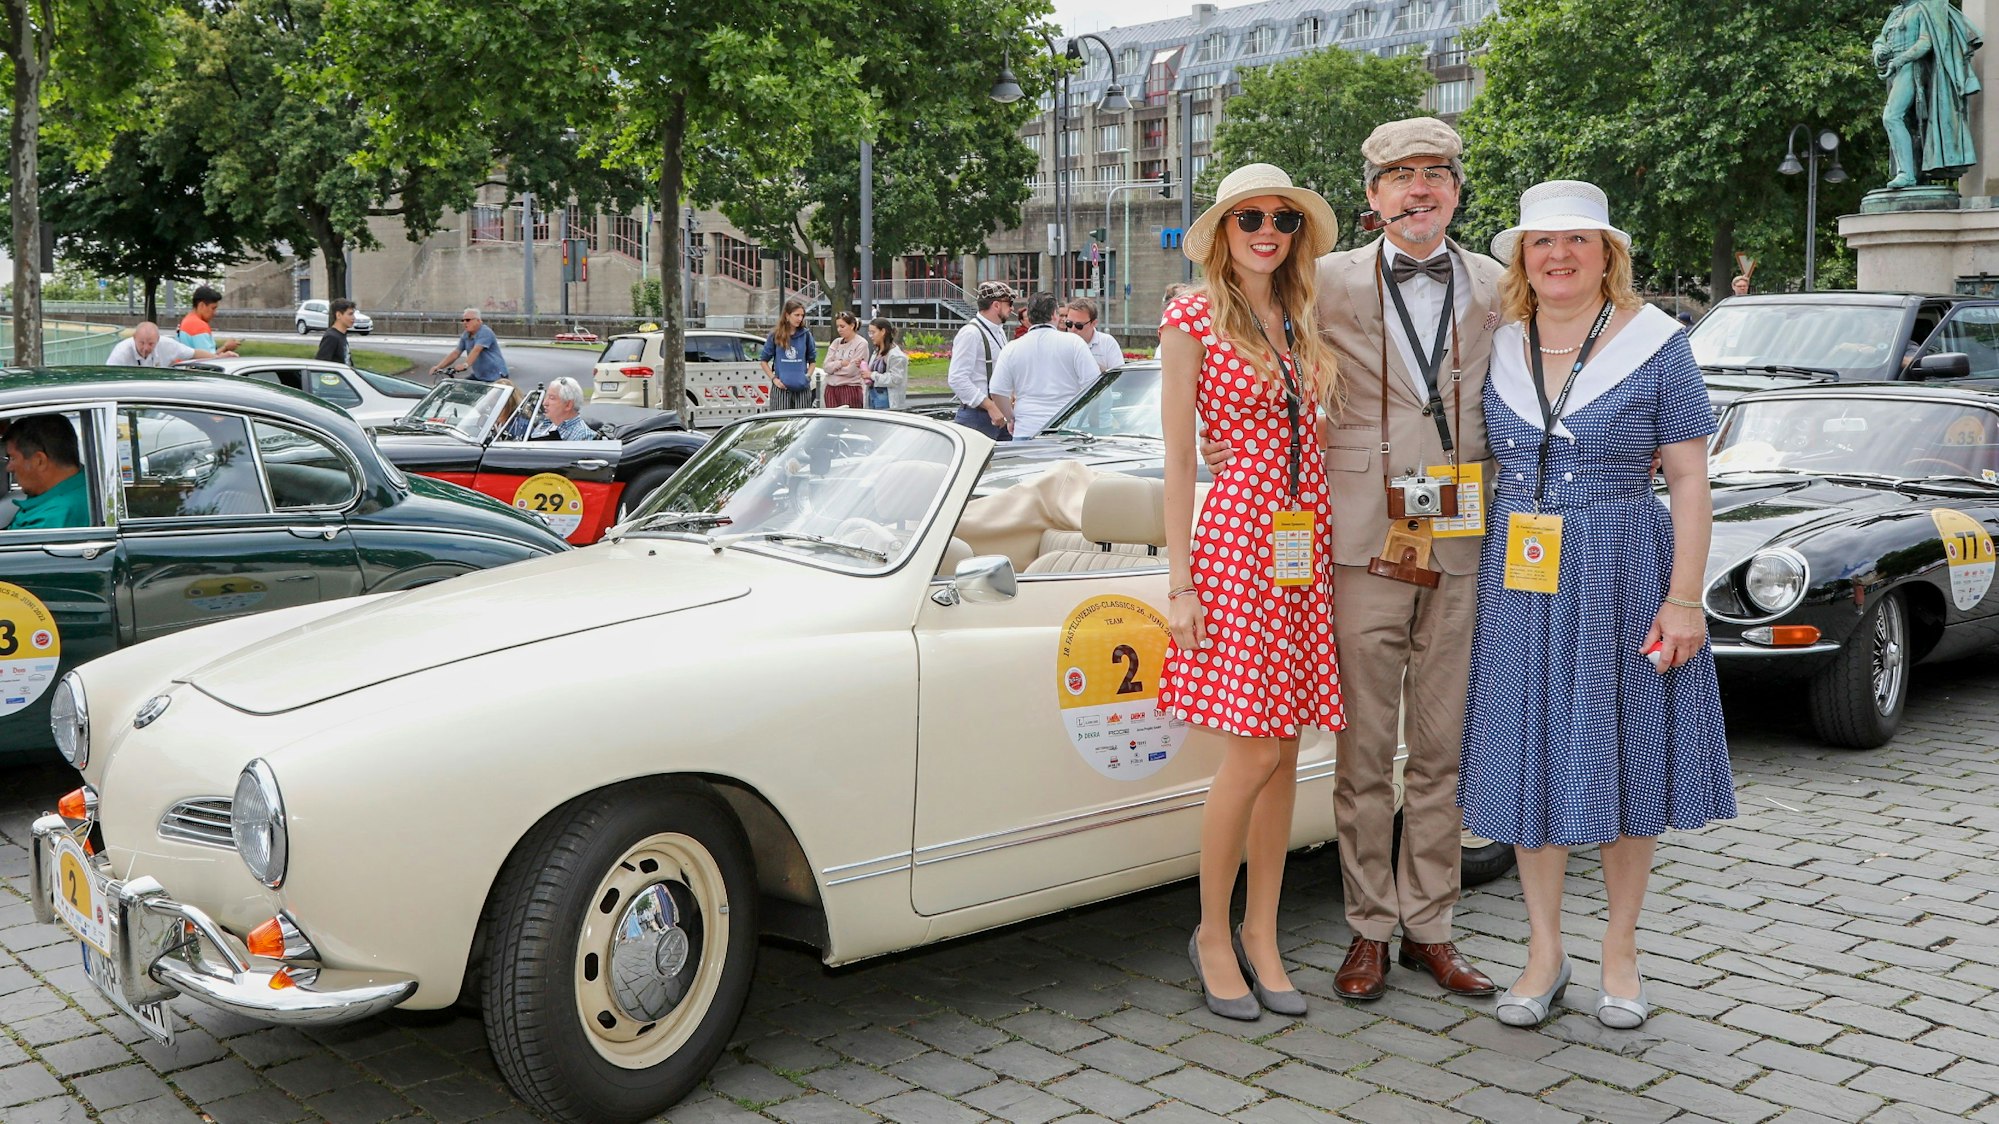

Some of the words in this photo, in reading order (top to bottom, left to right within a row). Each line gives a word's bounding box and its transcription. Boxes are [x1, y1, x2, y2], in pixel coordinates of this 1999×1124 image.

[534, 493, 564, 512] 29
[1954, 531, 1978, 560] 77
[1104, 618, 1124, 626] TEAM
[1147, 613, 1165, 629] JUNI
[1112, 644, 1143, 695] 2
[1084, 731, 1101, 740] DEKRA
[68, 869, 78, 906] 2
